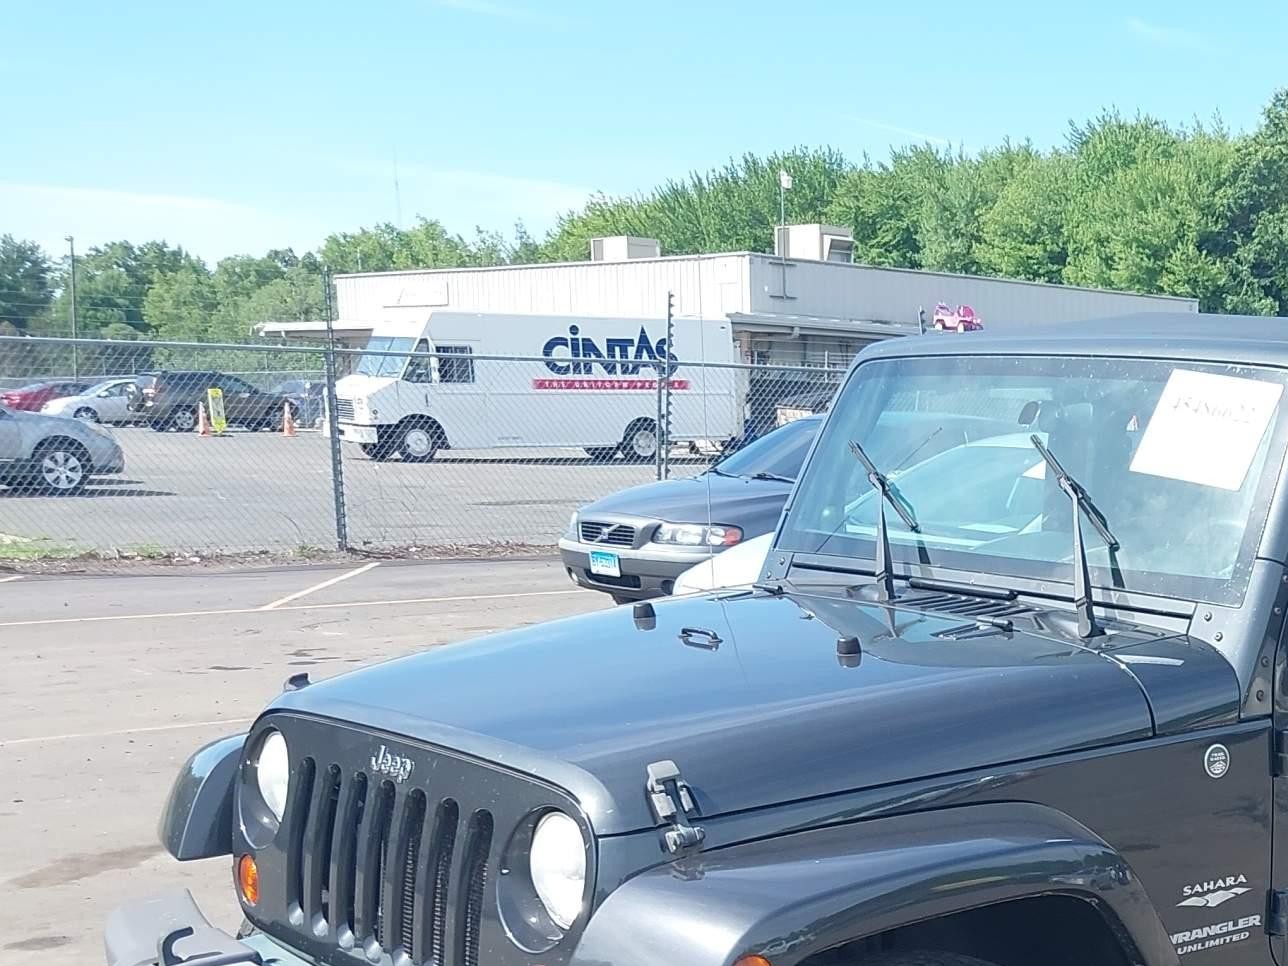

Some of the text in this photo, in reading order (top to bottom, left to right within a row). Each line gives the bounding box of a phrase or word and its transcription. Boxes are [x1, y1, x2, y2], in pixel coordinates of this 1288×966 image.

[370, 744, 414, 784] Jeep
[1183, 874, 1248, 896] SAHARA
[1177, 931, 1249, 955] UNLIMITED
